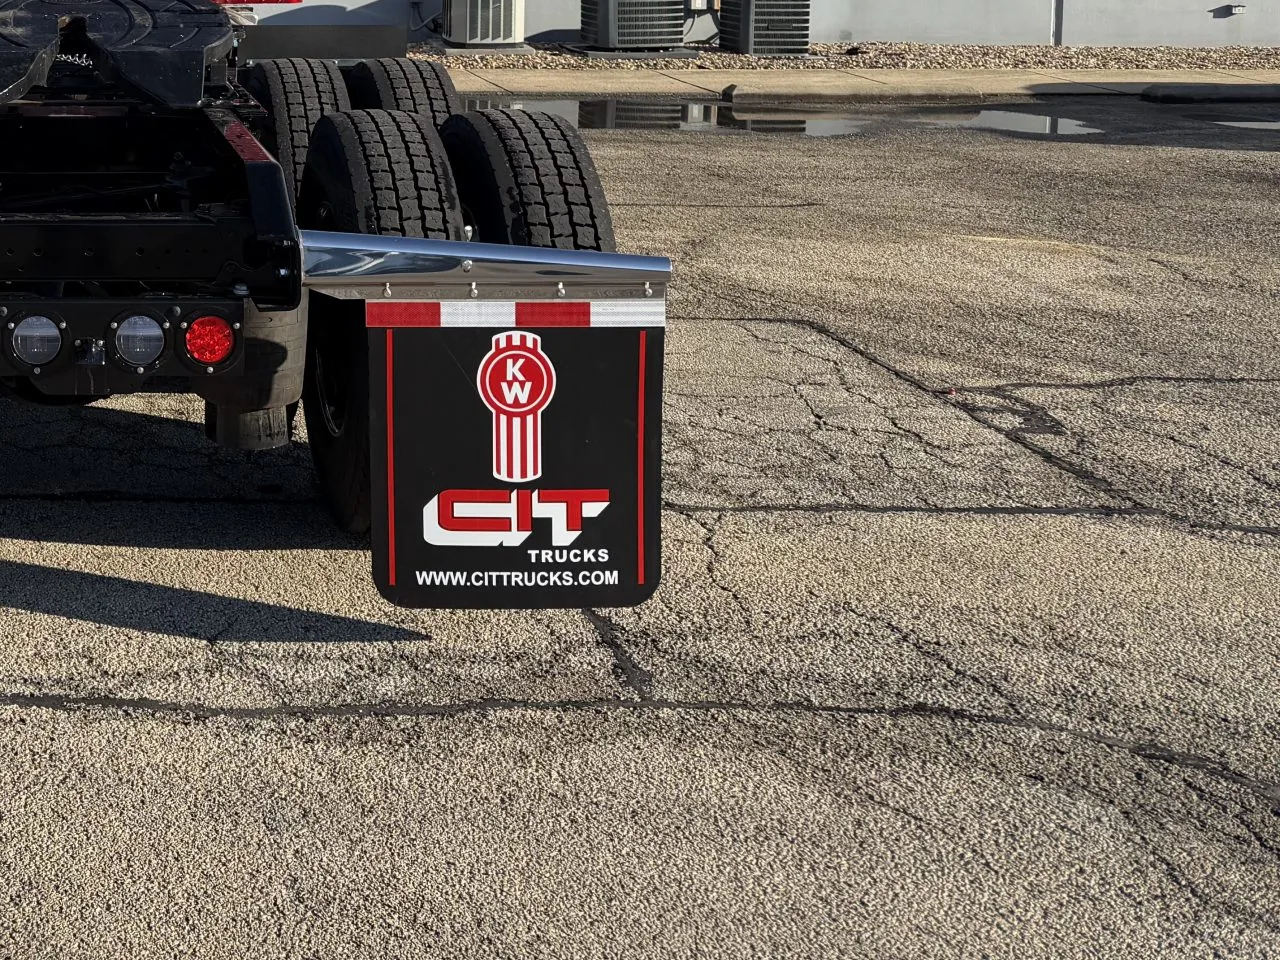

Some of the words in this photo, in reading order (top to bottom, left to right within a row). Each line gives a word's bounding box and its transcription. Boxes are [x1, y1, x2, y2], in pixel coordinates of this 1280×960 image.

[506, 358, 526, 381] K
[500, 381, 532, 405] W
[423, 489, 611, 547] CIT
[527, 549, 609, 563] TRUCKS
[415, 570, 619, 586] WWW.CITTRUCKS.COM
